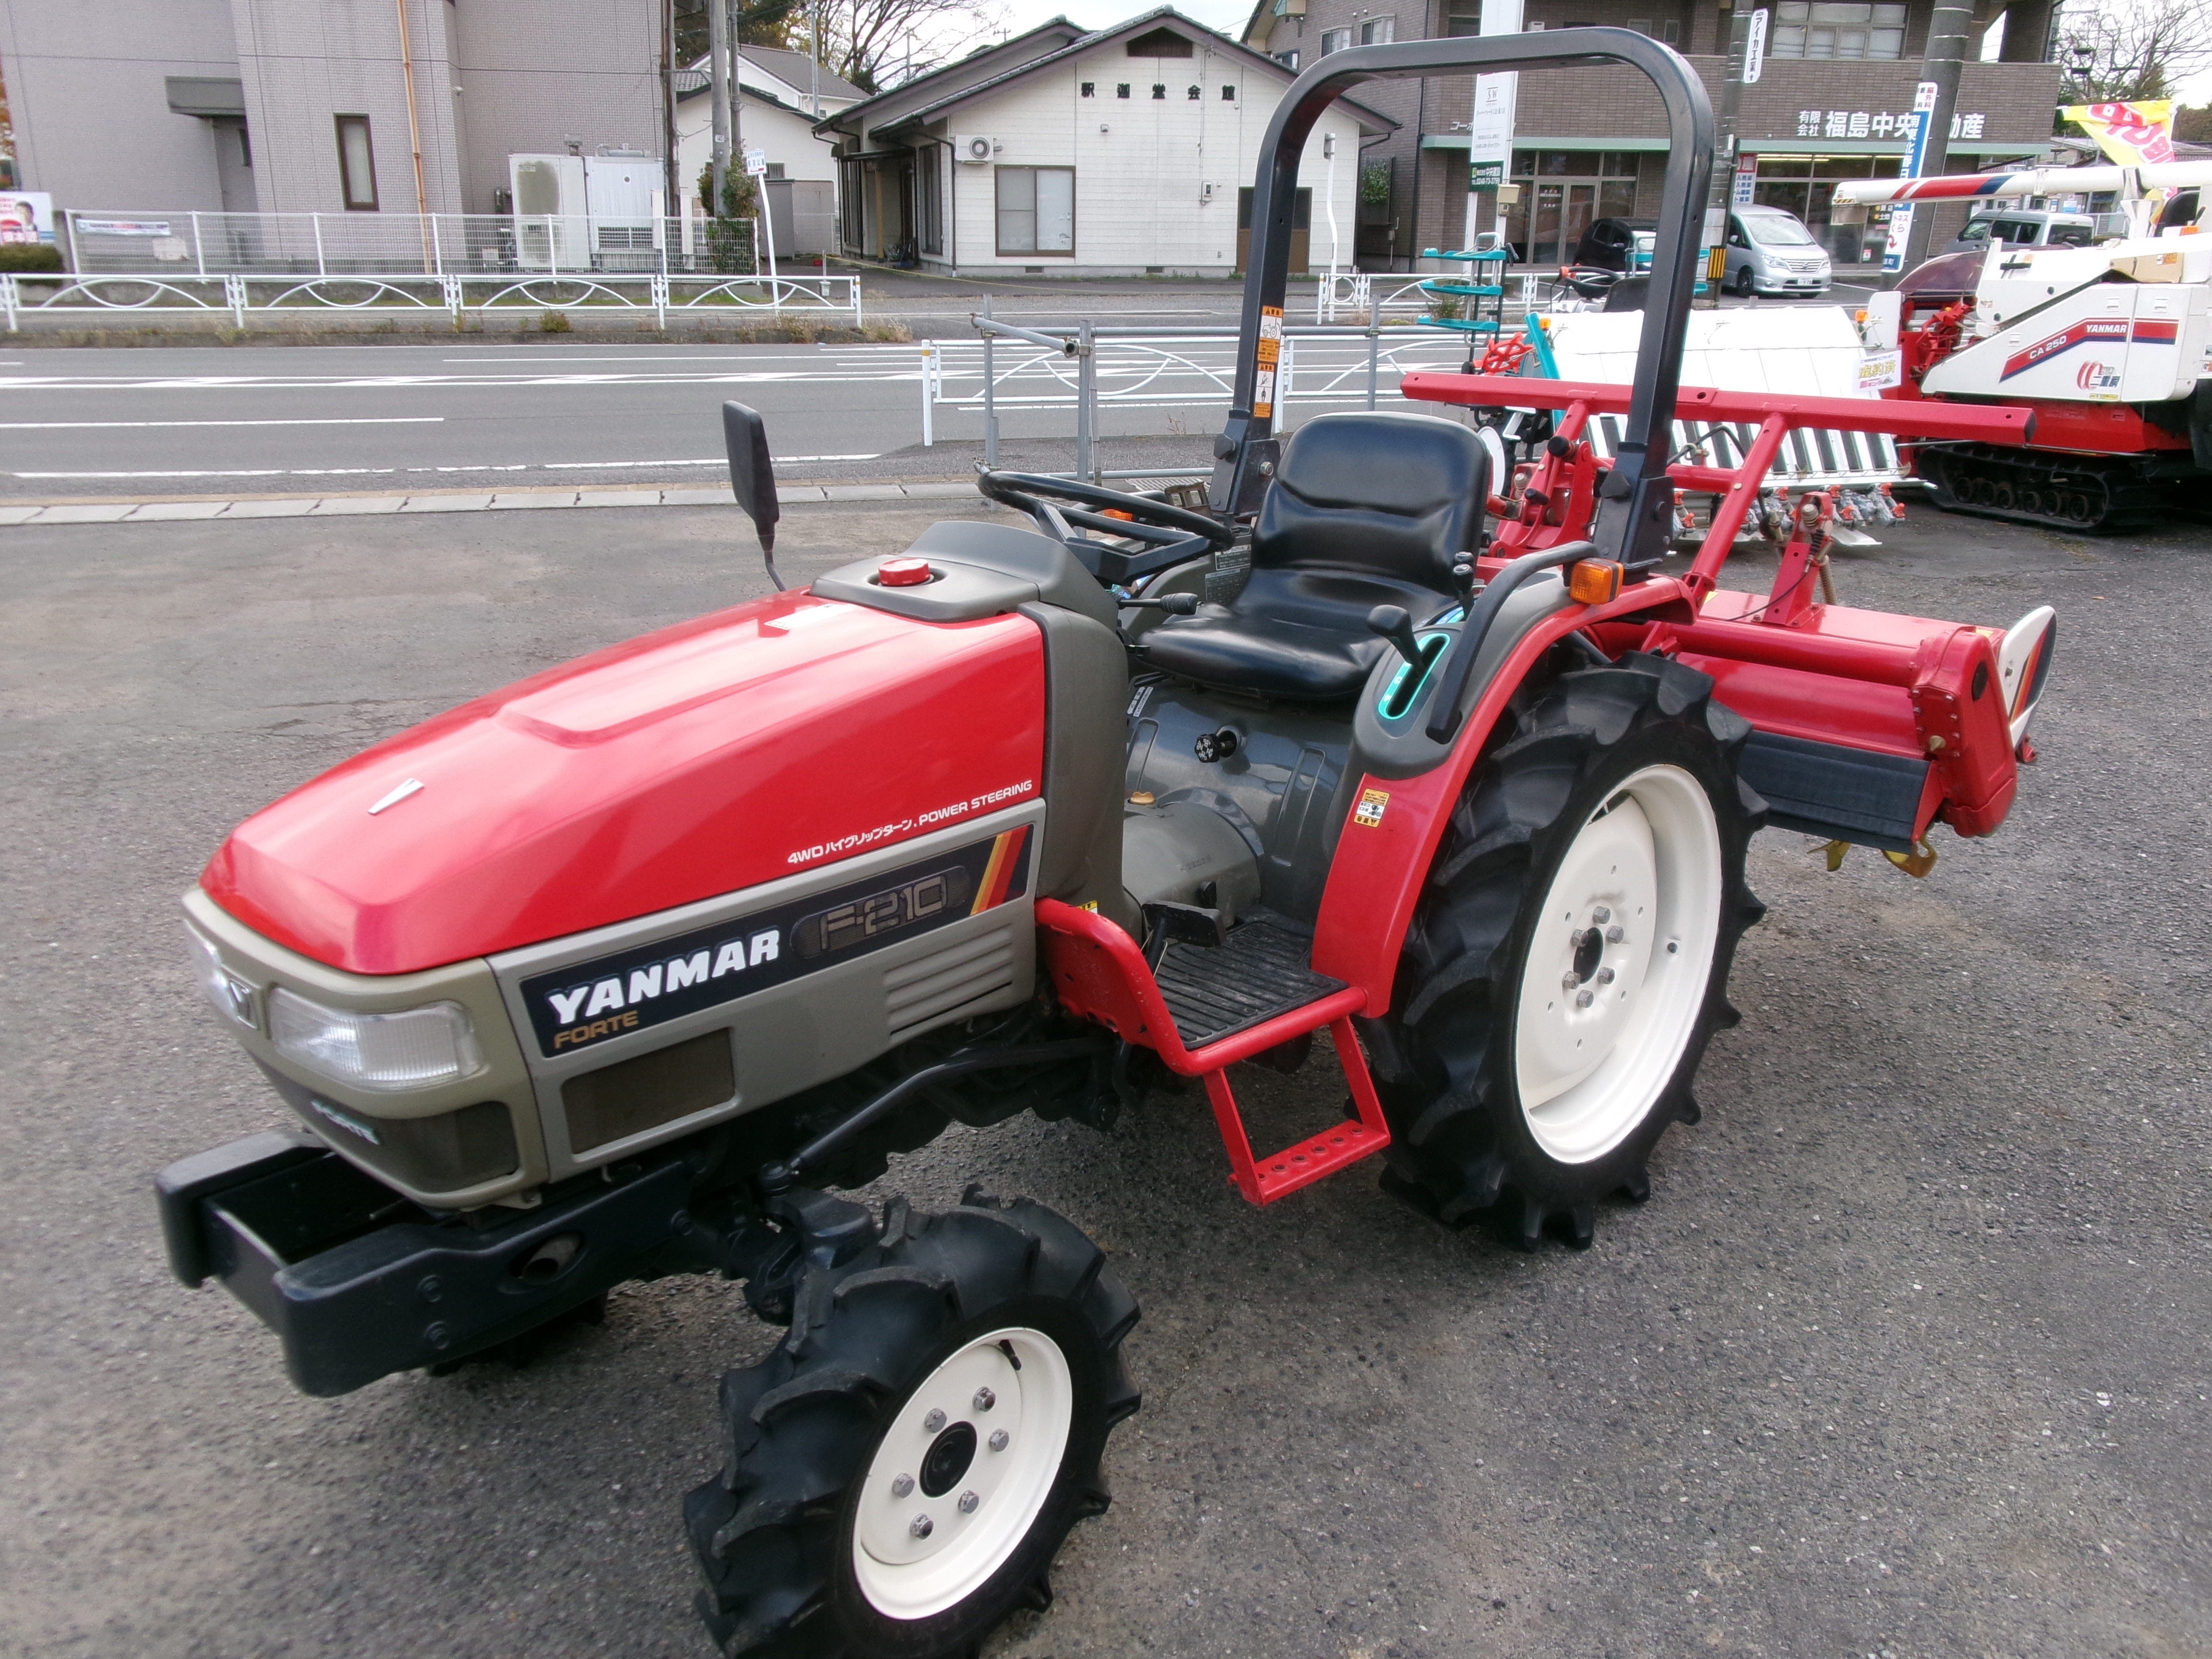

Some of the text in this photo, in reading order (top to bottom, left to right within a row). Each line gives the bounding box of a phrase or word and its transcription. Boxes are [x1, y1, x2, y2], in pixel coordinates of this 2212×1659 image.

[1750, 17, 1763, 72] アイカ工業
[1799, 111, 1821, 123] 有限
[1826, 111, 1985, 139] 福島中央産
[1797, 125, 1819, 136] 会社
[2086, 324, 2128, 334] YANMAR
[2029, 335, 2068, 360] CA 250
[1858, 360, 1896, 379] 成約済
[787, 844, 824, 865] 4WD
[918, 801, 969, 827] POWER
[971, 779, 1033, 810] STEERING
[549, 929, 780, 1025] YANMAR
[553, 1010, 639, 1050] FORTE
